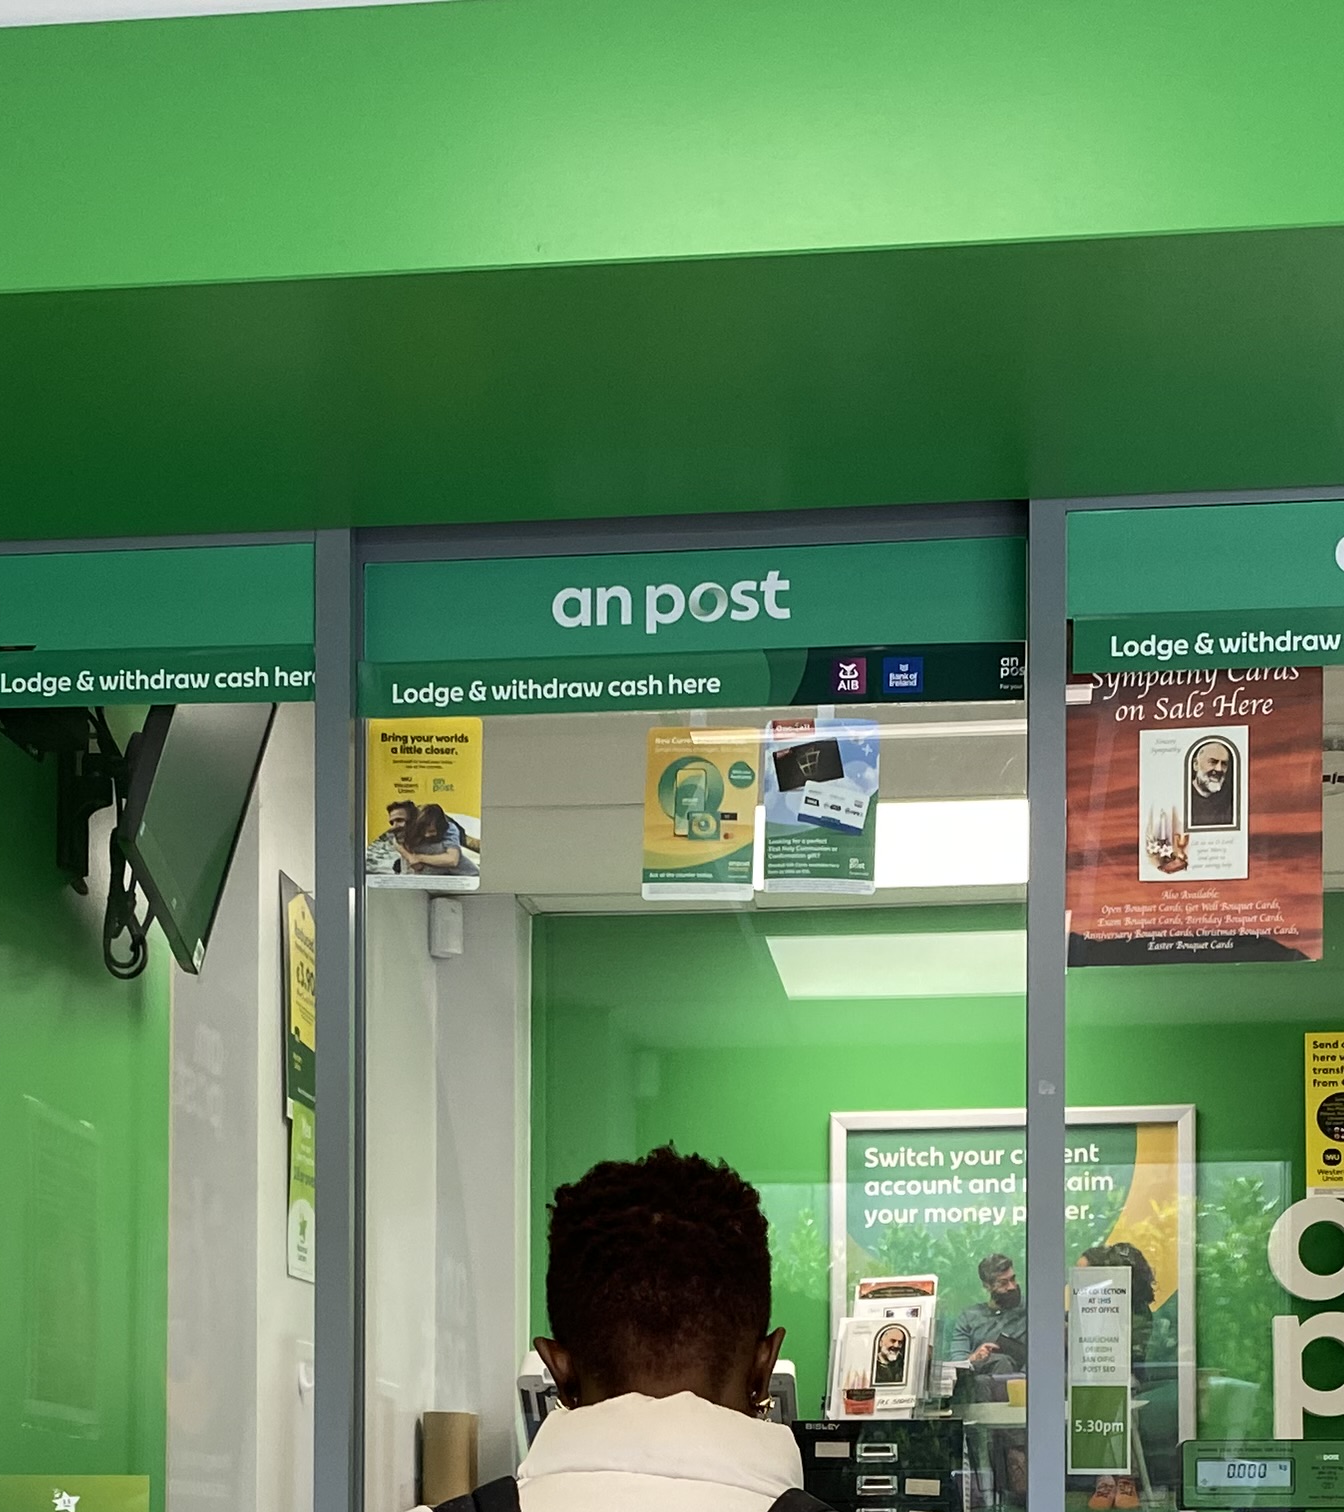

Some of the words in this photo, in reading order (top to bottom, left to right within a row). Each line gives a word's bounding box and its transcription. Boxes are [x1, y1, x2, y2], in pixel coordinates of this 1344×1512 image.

[552, 585, 633, 628] an
[645, 570, 792, 634] post
[1110, 634, 1189, 661] Lodge
[1194, 632, 1214, 655] &
[1219, 630, 1342, 654] withdraw
[1000, 657, 1019, 667] an
[0, 672, 72, 697] Lodge
[76, 670, 94, 692] &
[99, 668, 210, 691] withdraw
[215, 666, 269, 688] cash
[837, 679, 860, 691] AIB
[392, 682, 464, 708] Lodge
[468, 680, 487, 701] &
[491, 677, 603, 701] withdraw
[607, 674, 663, 697] cash
[668, 673, 721, 695] here
[1115, 703, 1145, 721] on
[1154, 690, 1204, 720] Sale
[1213, 687, 1273, 716] Here
[380, 733, 408, 746] Bring
[411, 733, 435, 746] your
[437, 733, 469, 746] worlds
[400, 745, 422, 755] little
[1313, 1040, 1338, 1049] Send
[1313, 1054, 1337, 1062] here
[1313, 1078, 1338, 1087] from
[864, 1146, 944, 1168] Switch
[950, 1149, 1004, 1170] your
[864, 1176, 961, 1196] account
[969, 1173, 1015, 1193] and
[864, 1207, 918, 1228] your
[924, 1204, 1005, 1226] money
[1075, 1420, 1124, 1435] 5.30pm
[1227, 1463, 1267, 1478] 0.000
